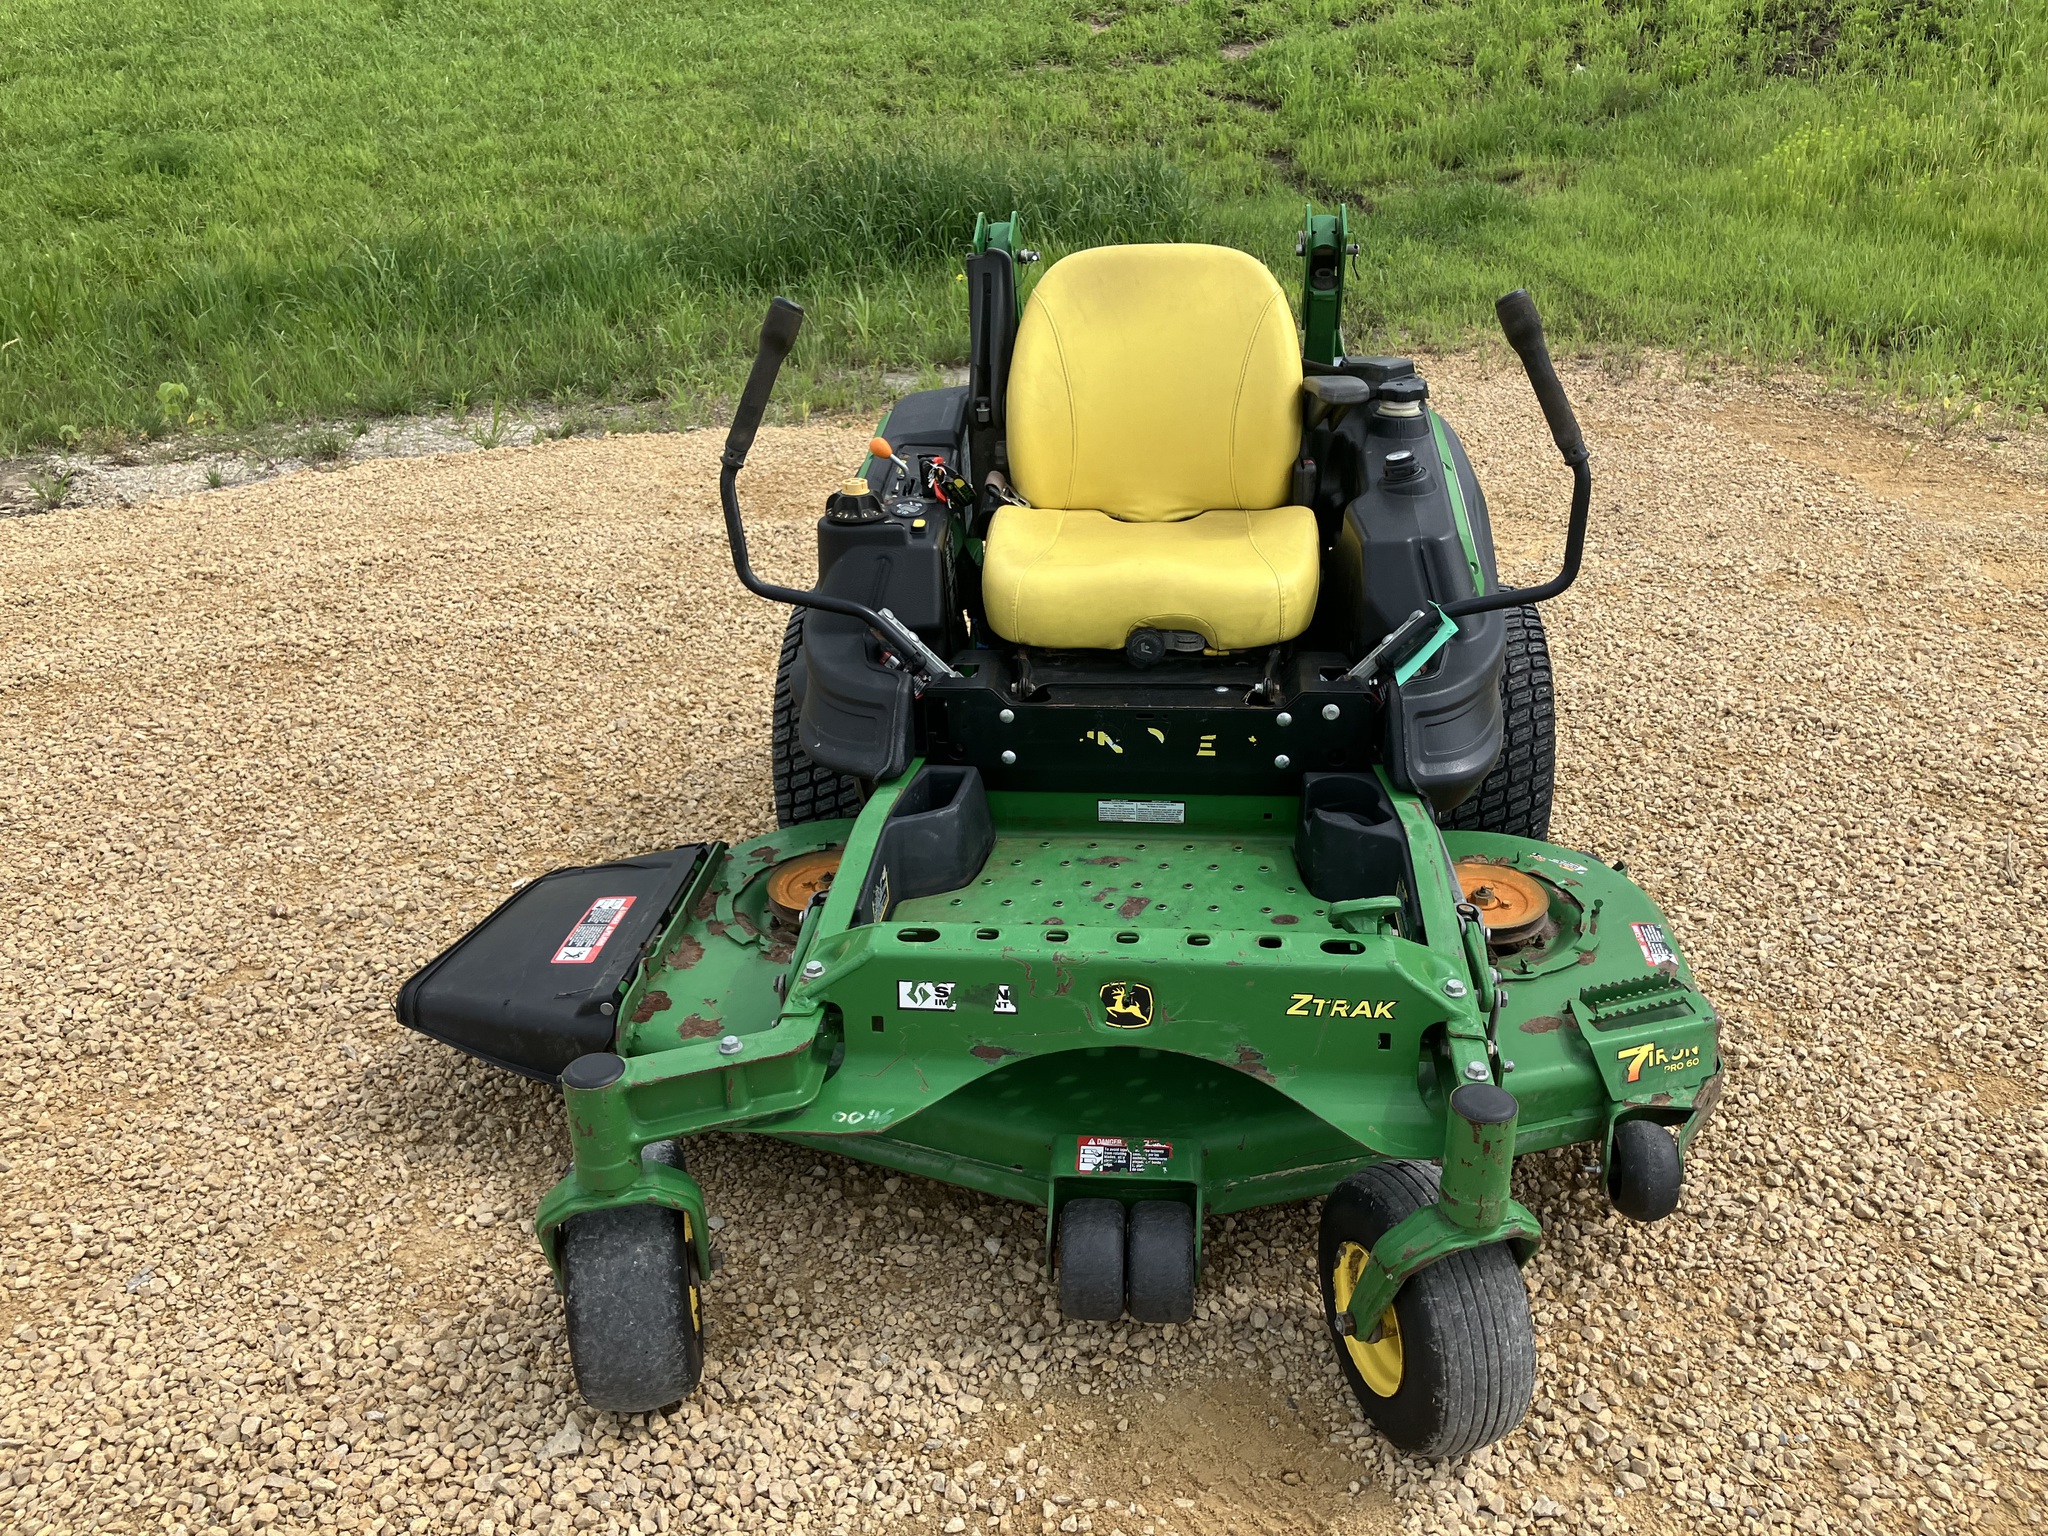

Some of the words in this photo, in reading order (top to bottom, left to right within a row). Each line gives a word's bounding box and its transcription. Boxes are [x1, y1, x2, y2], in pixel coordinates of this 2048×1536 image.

[1286, 993, 1398, 1019] ZTRAK
[1617, 1042, 1655, 1083] 7
[1664, 1062, 1684, 1074] PRO
[1686, 1057, 1700, 1068] 60
